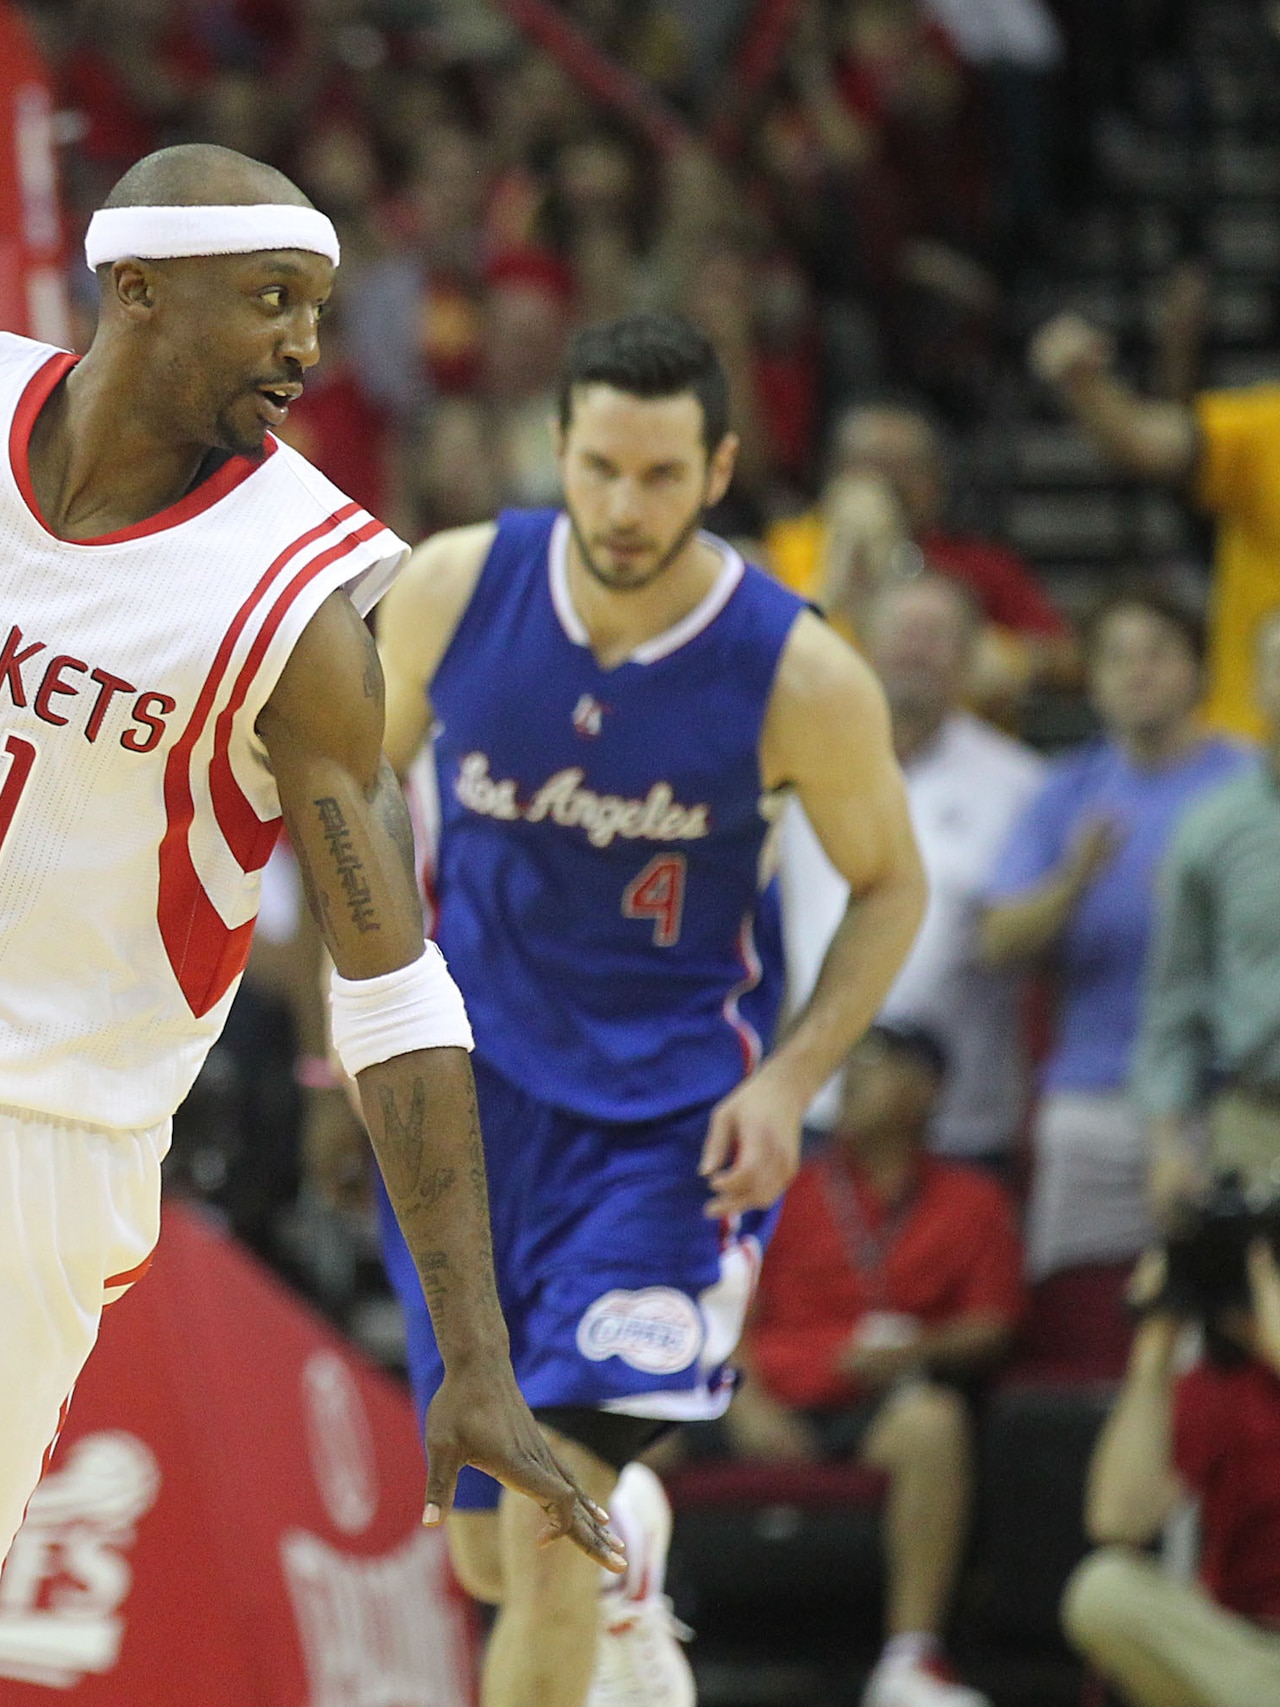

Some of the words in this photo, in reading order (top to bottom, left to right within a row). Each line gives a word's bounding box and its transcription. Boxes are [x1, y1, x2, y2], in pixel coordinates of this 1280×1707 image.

[454, 751, 522, 822] Los
[523, 766, 711, 848] Angeles
[622, 853, 688, 947] 4
